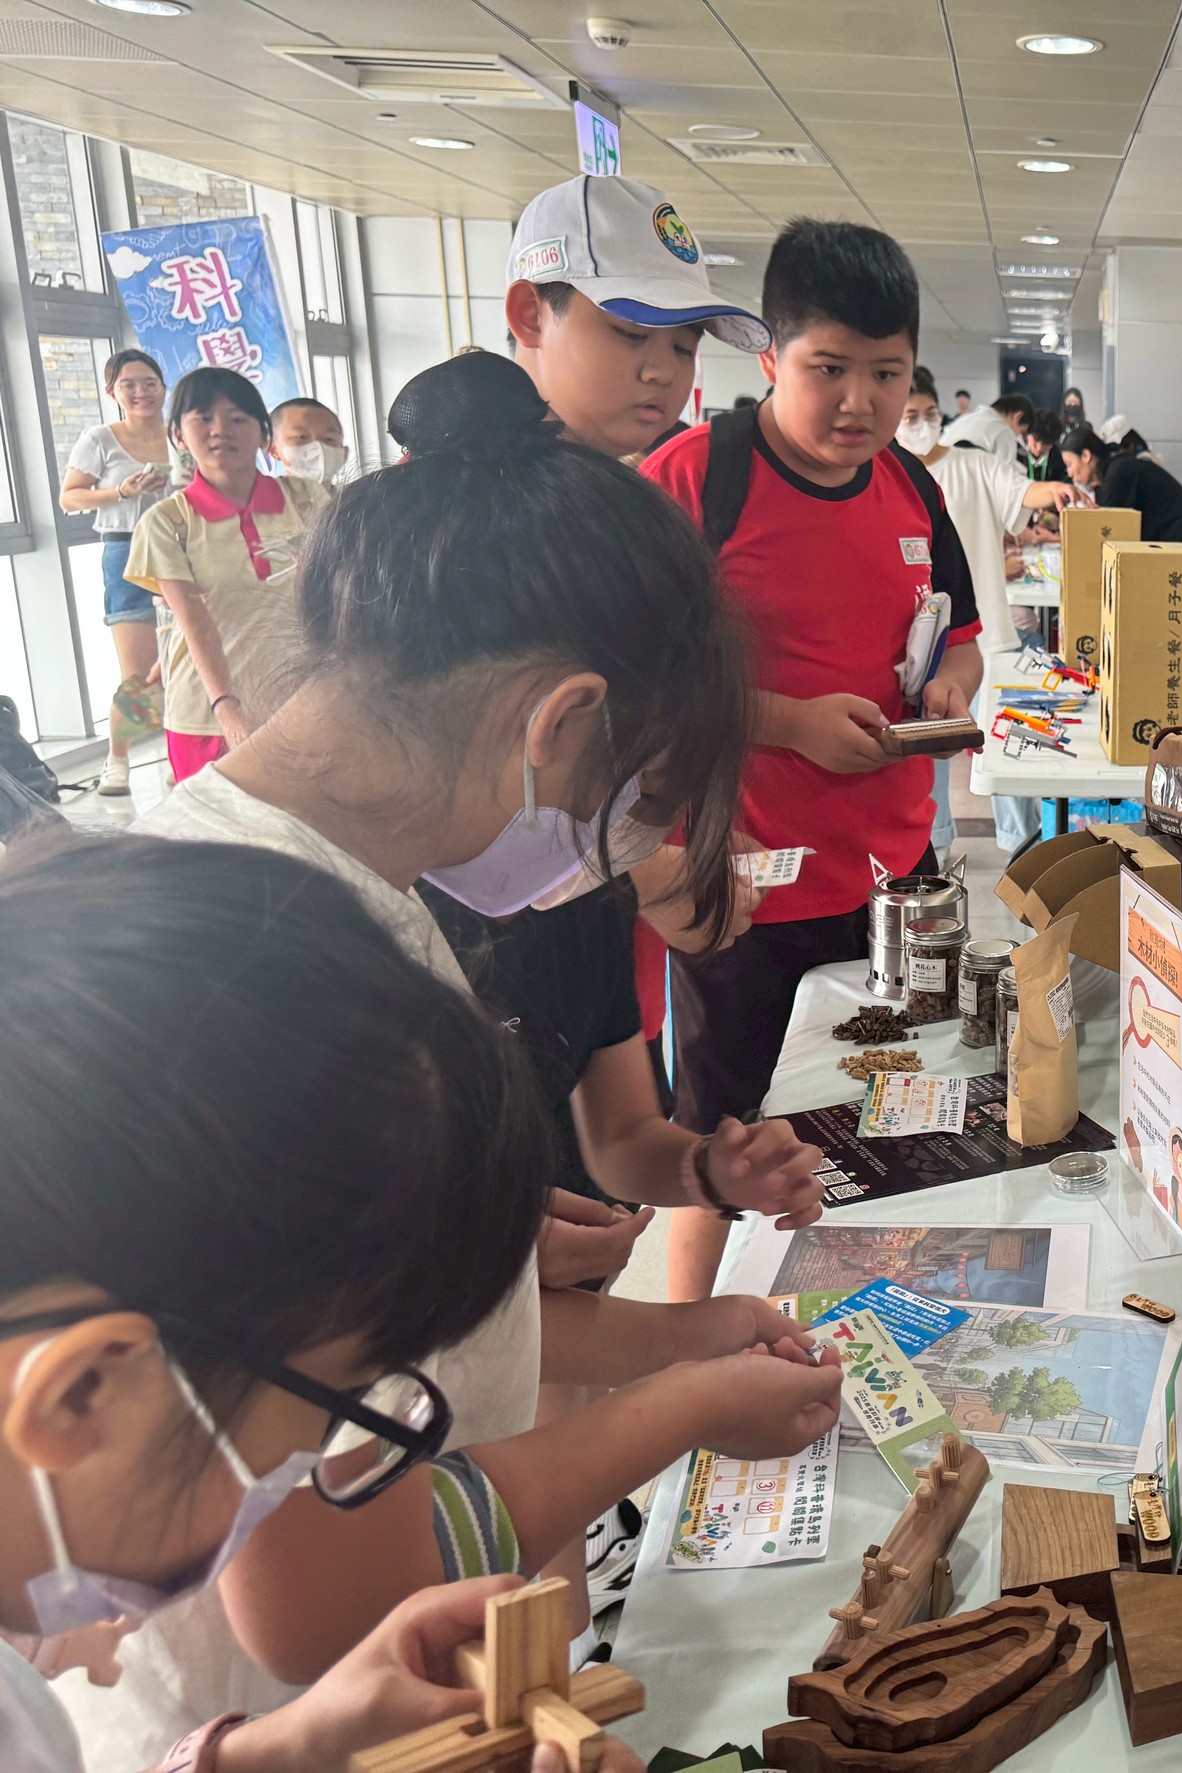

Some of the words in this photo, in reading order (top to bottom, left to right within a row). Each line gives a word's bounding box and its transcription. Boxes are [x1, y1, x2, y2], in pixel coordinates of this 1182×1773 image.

[805, 1463, 828, 1546] 台灣科普環島列車
[1139, 1509, 1160, 1539] WOOD
